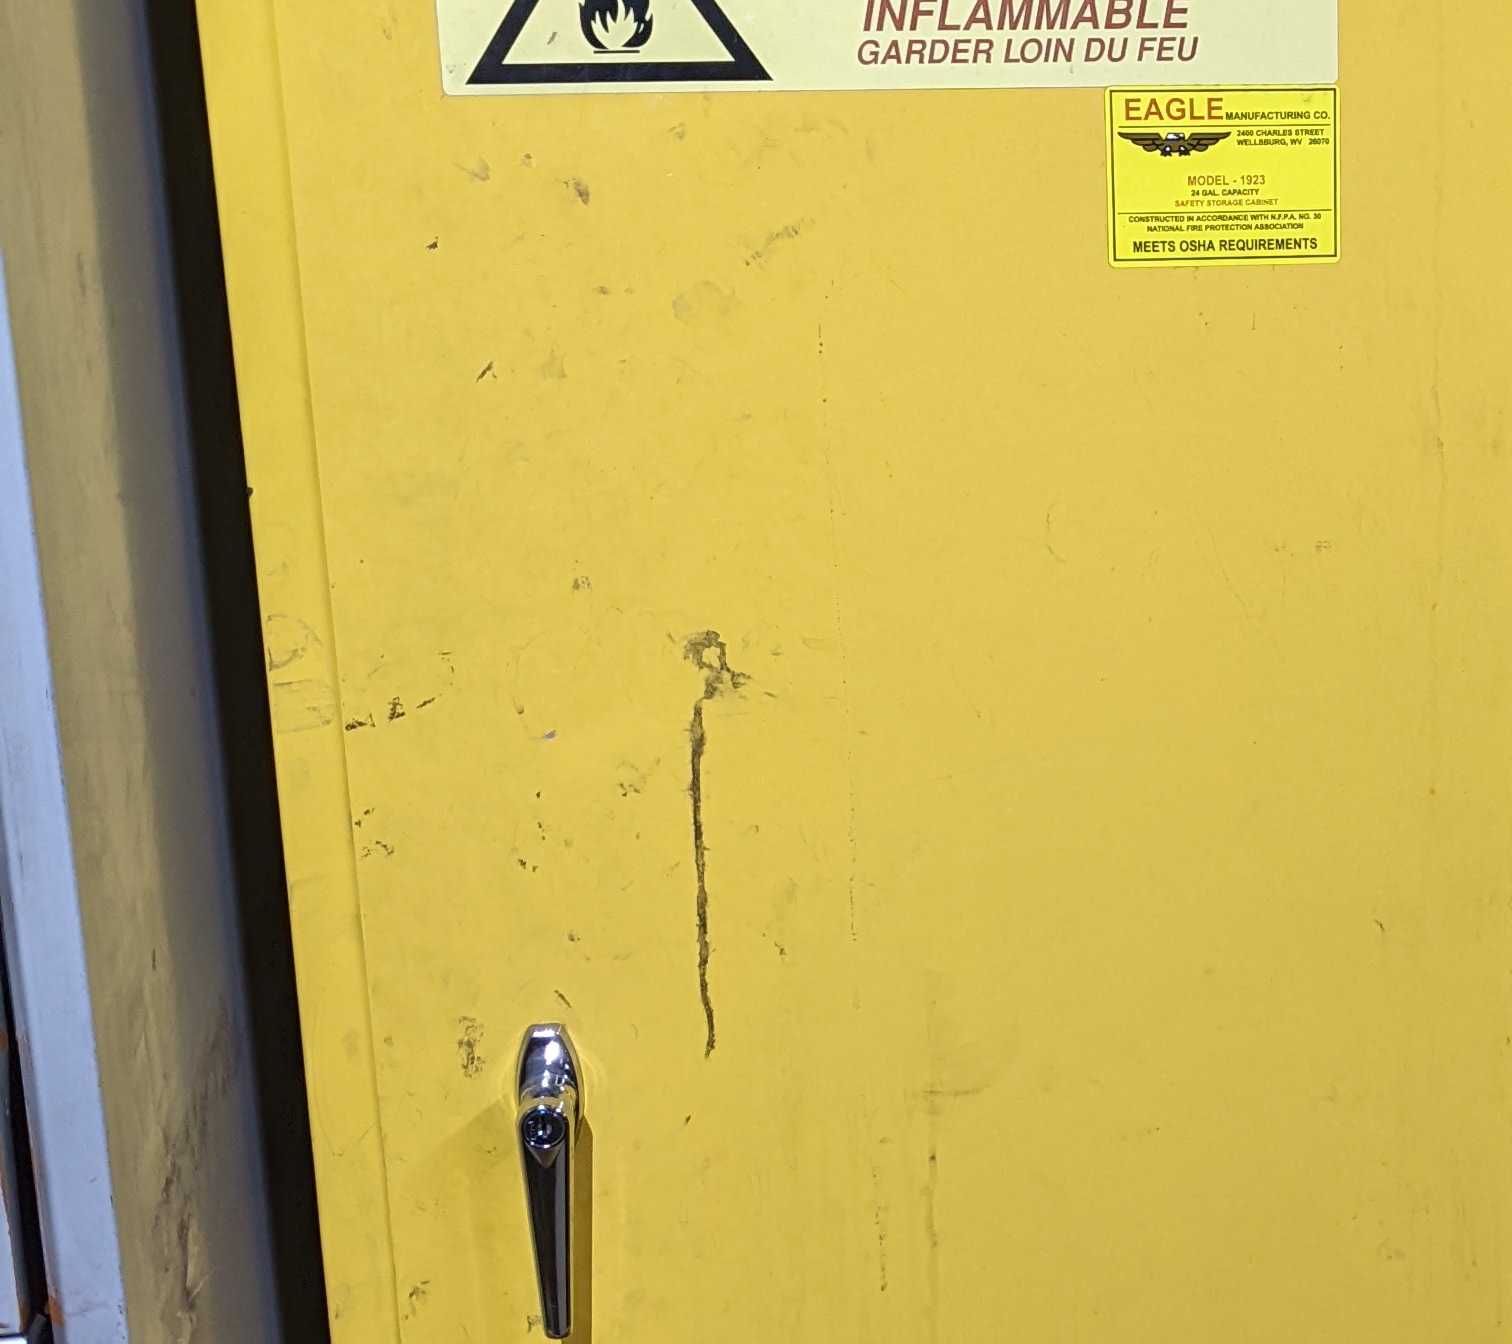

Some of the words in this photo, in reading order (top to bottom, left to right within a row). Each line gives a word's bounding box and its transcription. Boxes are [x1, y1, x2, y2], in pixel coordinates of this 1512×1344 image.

[857, 38, 996, 65] GARDER
[1003, 37, 1075, 63] LOIN
[1084, 37, 1129, 63] DU
[1137, 36, 1199, 62] FEU
[1124, 97, 1224, 121] EAGLE
[1225, 110, 1311, 121] MANUFACTURING
[1313, 110, 1331, 120] CO.
[1255, 129, 1292, 137] CHARLES
[1294, 128, 1324, 136] STREET
[1290, 138, 1303, 146] WV
[1187, 175, 1230, 186] MODEL
[1240, 174, 1266, 186] 1923
[1191, 189, 1200, 197] 24
[1221, 188, 1260, 196] CAPACITY
[1174, 199, 1205, 208] SAFETY
[1206, 199, 1243, 207] STORAGE
[1245, 198, 1278, 206] CABINET
[1128, 215, 1184, 223] CONSTRUCTED
[1195, 214, 1248, 222] ACCORDANCE
[1250, 213, 1269, 221] WITH
[1147, 224, 1184, 232] NATIONAL
[1204, 223, 1253, 231] PROTECTION
[1254, 222, 1303, 230] ASSOCIATION
[1133, 240, 1176, 253] MEETS
[1179, 239, 1216, 252] OSHA
[1219, 237, 1318, 251] REQUIREMENTS
